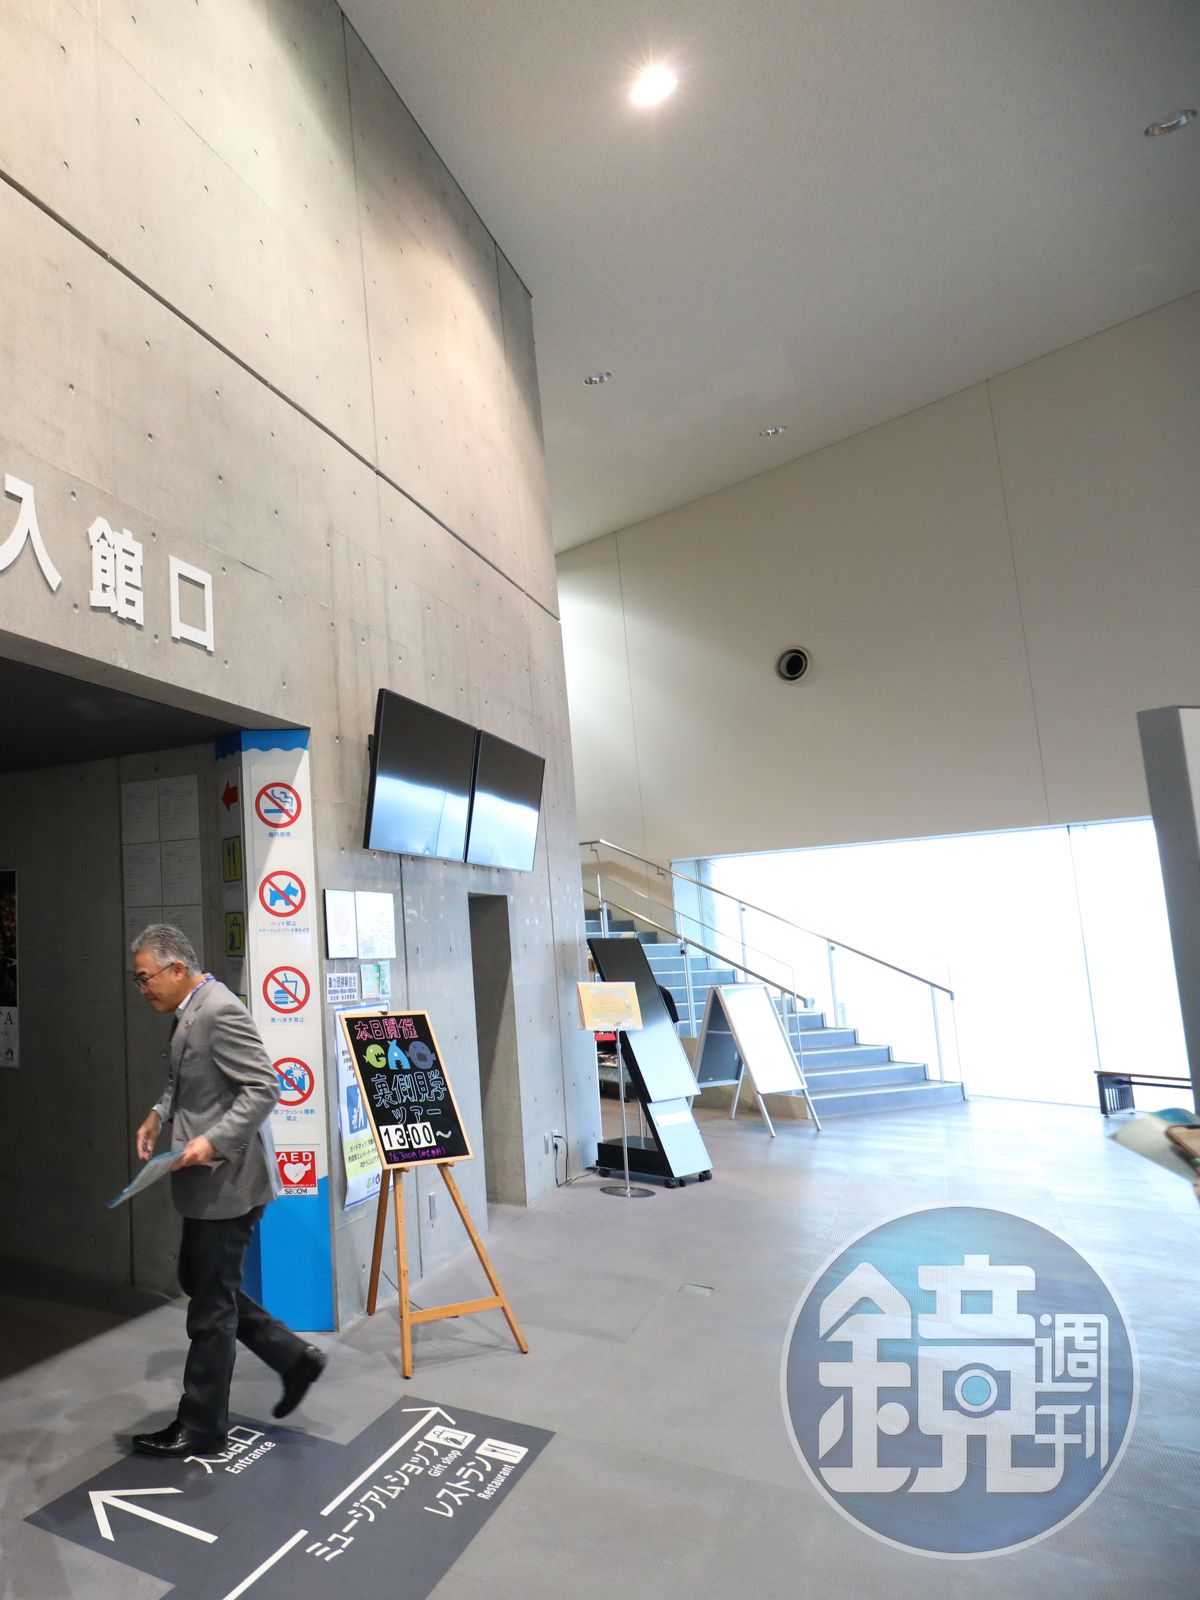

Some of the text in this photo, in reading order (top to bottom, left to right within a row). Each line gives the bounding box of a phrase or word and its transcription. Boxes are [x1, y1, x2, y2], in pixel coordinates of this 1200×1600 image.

[354, 1018, 418, 1040] 本日開催
[371, 1069, 447, 1108] 裏側見学
[392, 1106, 441, 1125] ツアー
[277, 1152, 312, 1162] AED
[225, 1441, 276, 1474] Entrance
[428, 1449, 462, 1477] Gift shop
[424, 1456, 492, 1518] レストラン
[477, 1463, 516, 1500] Restaurant
[306, 1441, 439, 1561] ミュージアムショップ
